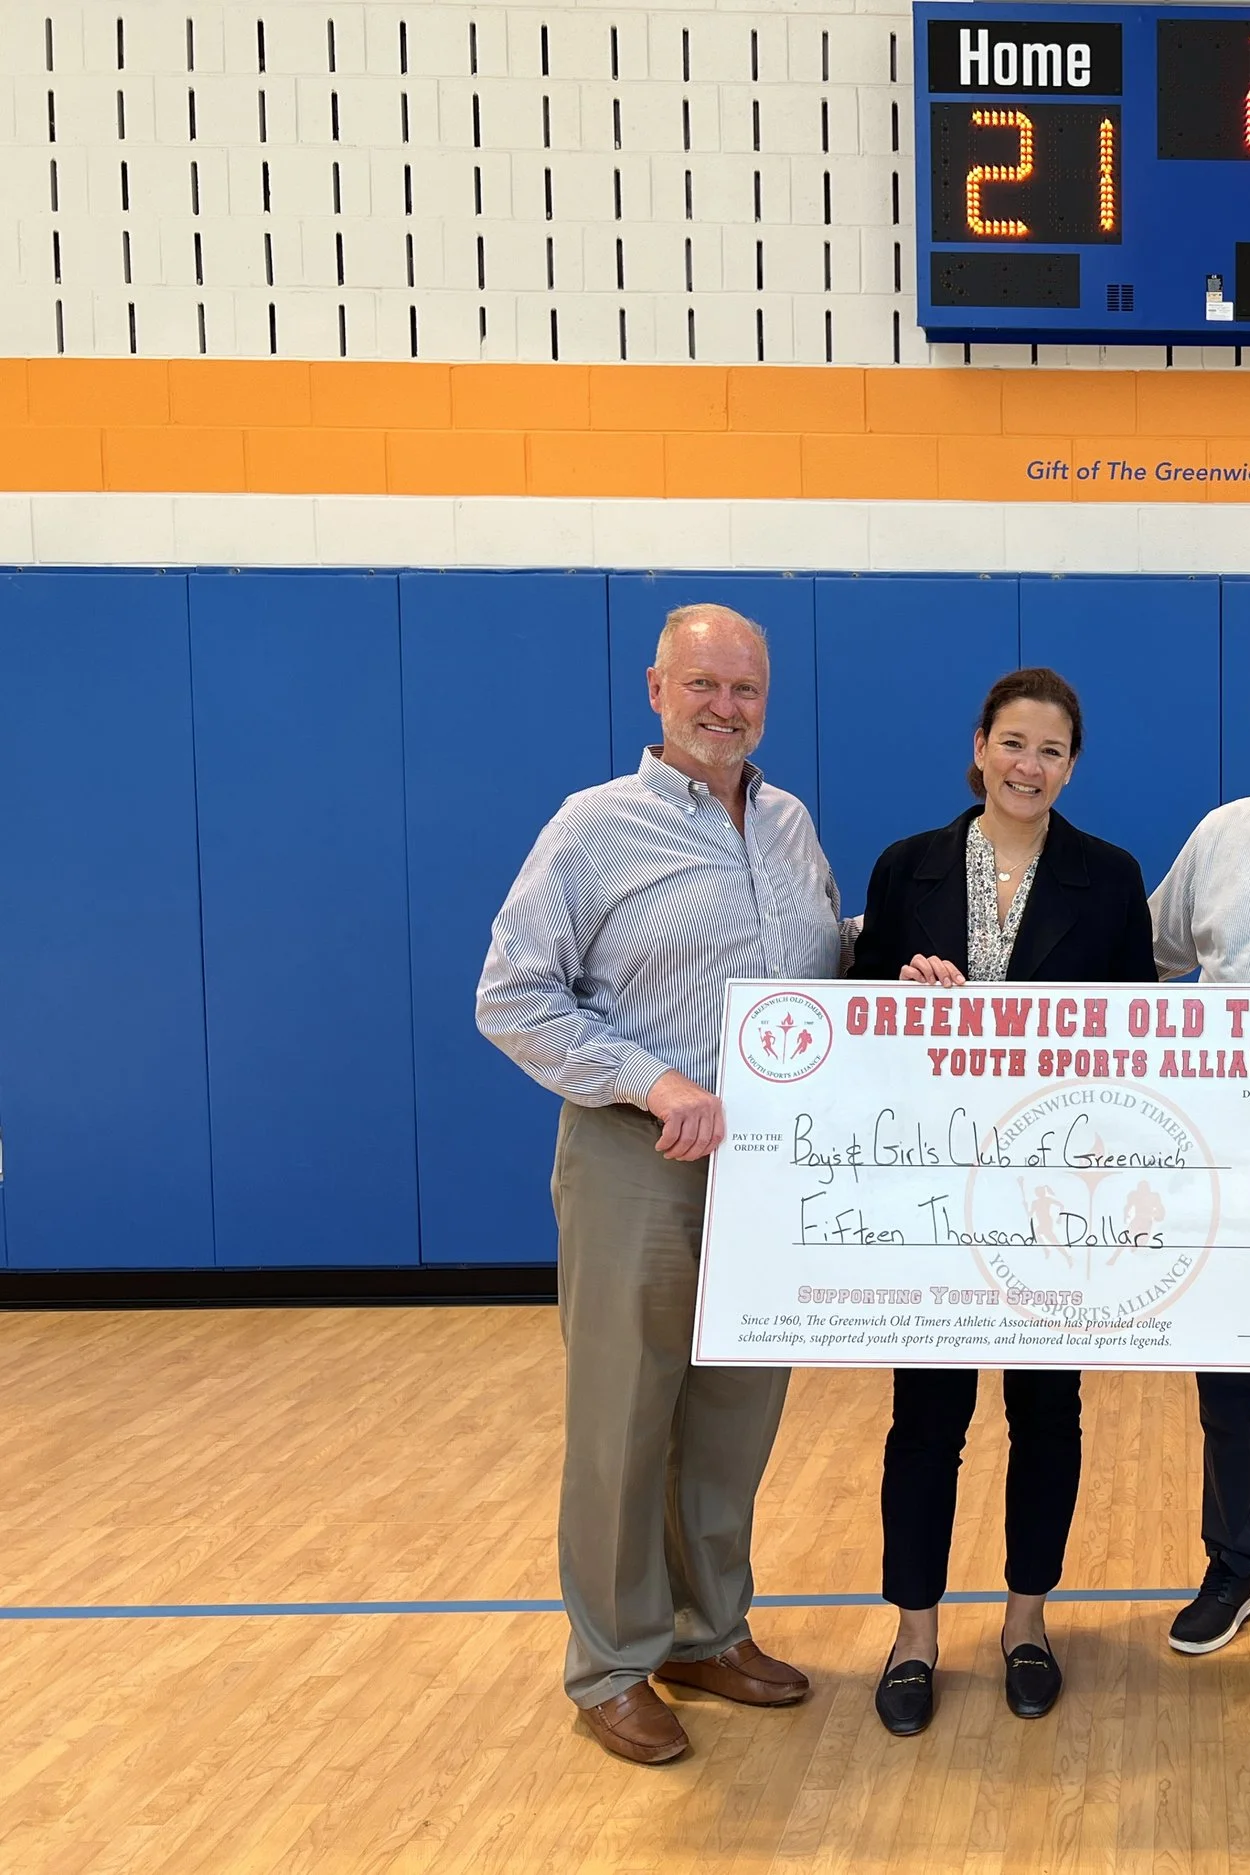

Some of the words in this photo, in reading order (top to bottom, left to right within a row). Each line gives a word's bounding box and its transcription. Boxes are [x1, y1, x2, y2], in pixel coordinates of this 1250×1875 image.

[960, 29, 1090, 86] Home
[966, 110, 1114, 236] 21
[1027, 461, 1069, 479] Gift
[1077, 461, 1101, 479] of
[1107, 461, 1146, 480] The
[751, 996, 789, 1019] GREENWICH
[789, 996, 804, 1004] OLD
[804, 1000, 824, 1020] TIMERS
[846, 997, 1108, 1037] GREENWICH
[1128, 999, 1204, 1038] OLD
[747, 1054, 767, 1074] YOUTH
[766, 1070, 792, 1079] SPORTS
[792, 1054, 822, 1078] ALLIANCE
[927, 1048, 1026, 1076] YOUTH
[1038, 1049, 1147, 1077] SPORTS
[997, 1089, 1095, 1152] GREENWICH
[1100, 1090, 1136, 1110] OLD
[1140, 1100, 1194, 1154] TIMERS
[732, 1133, 748, 1142] PAY
[765, 1133, 783, 1142] THE
[767, 1144, 779, 1152] OF
[789, 1113, 842, 1185] Boy's
[845, 1132, 864, 1184] &
[873, 1108, 941, 1167] Girl's
[948, 1107, 1011, 1168] Club
[1026, 1130, 1056, 1168] of
[1063, 1113, 1187, 1170] Greenwich
[917, 1194, 1037, 1247] Thousand
[1058, 1212, 1165, 1250] Dollars
[798, 1285, 922, 1304] SUPPORTING
[930, 1286, 1000, 1305] YOUTH
[1006, 1287, 1083, 1306] SPORTS
[1117, 1253, 1193, 1316] ALLIANCE
[741, 1315, 769, 1325] Since
[774, 1315, 801, 1326] 1960,
[807, 1315, 826, 1325] The
[829, 1315, 886, 1326] Greenwich
[890, 1316, 911, 1326] Old
[915, 1316, 950, 1326] Timers
[954, 1316, 996, 1327] Athletic
[999, 1317, 1060, 1327] Association
[1064, 1317, 1083, 1329] has
[1084, 1318, 1139, 1332] provided
[1137, 1318, 1172, 1332] college
[738, 1331, 805, 1345] scholarships,
[810, 1332, 864, 1346] supported
[866, 1333, 897, 1346] youth
[902, 1335, 933, 1347] sports
[936, 1336, 990, 1347] programs,
[994, 1333, 1016, 1344] and
[1019, 1333, 1063, 1344] honored
[1067, 1334, 1092, 1345] local
[1095, 1337, 1126, 1348] sports
[1130, 1335, 1171, 1349] legends.
